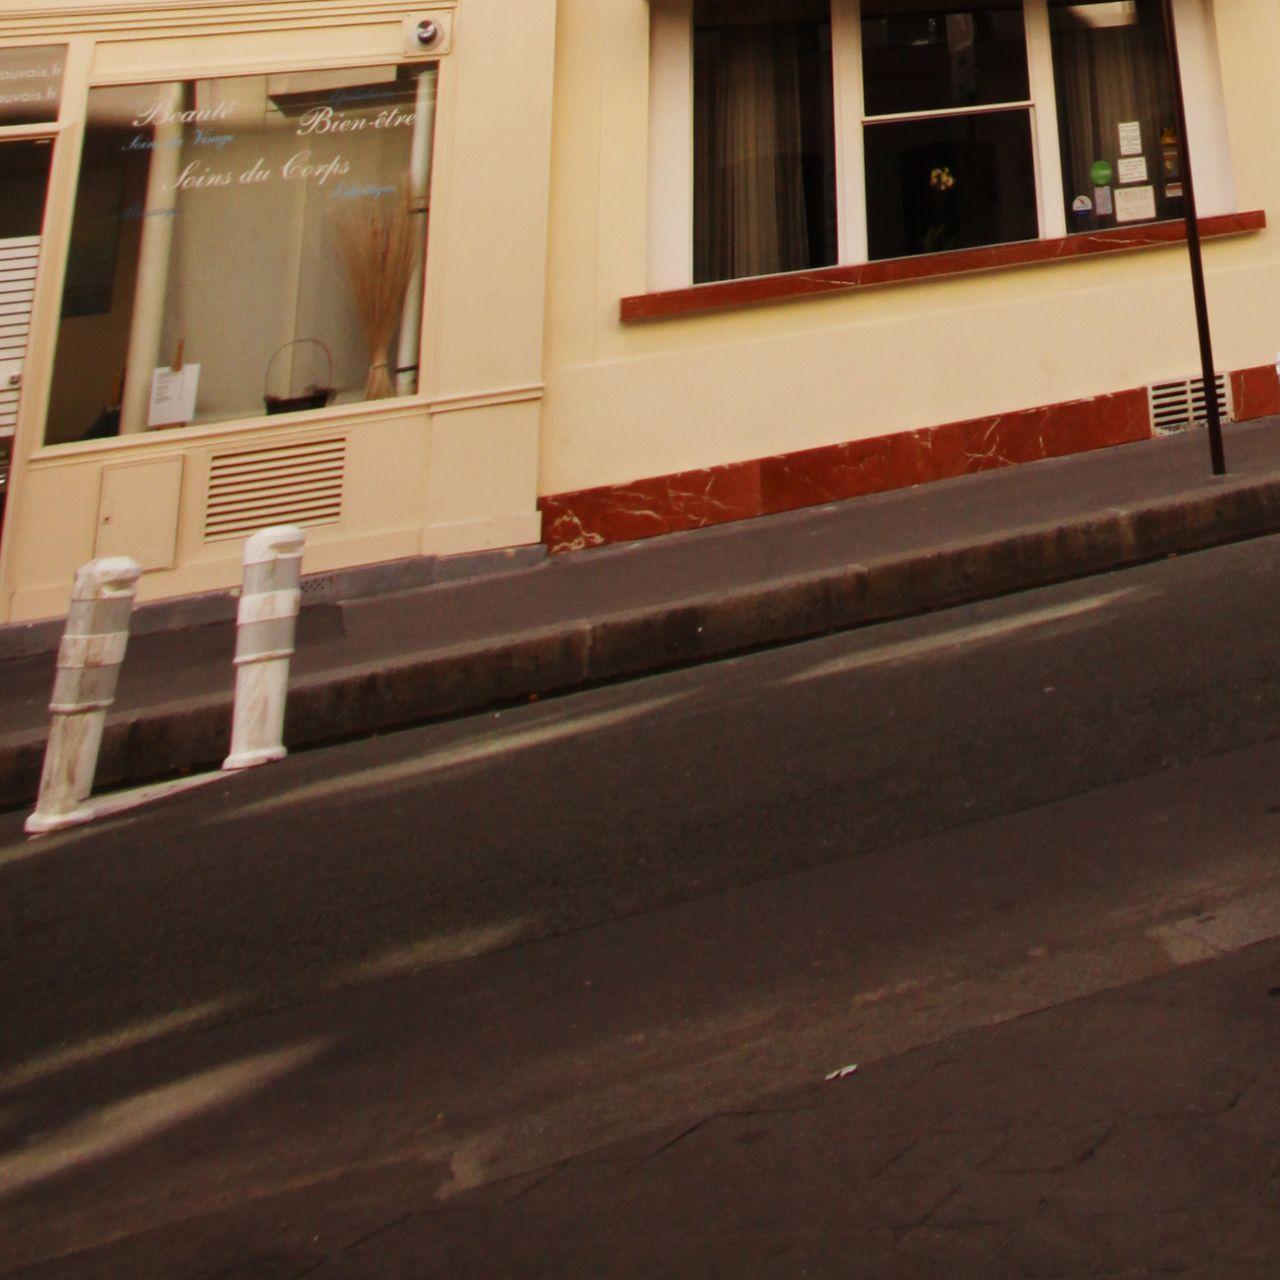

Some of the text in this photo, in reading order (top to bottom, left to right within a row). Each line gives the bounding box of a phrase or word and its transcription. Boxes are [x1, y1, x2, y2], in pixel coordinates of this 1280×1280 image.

[297, 106, 416, 135] Bien-être
[240, 158, 271, 184] du
[282, 149, 350, 186] Corps
